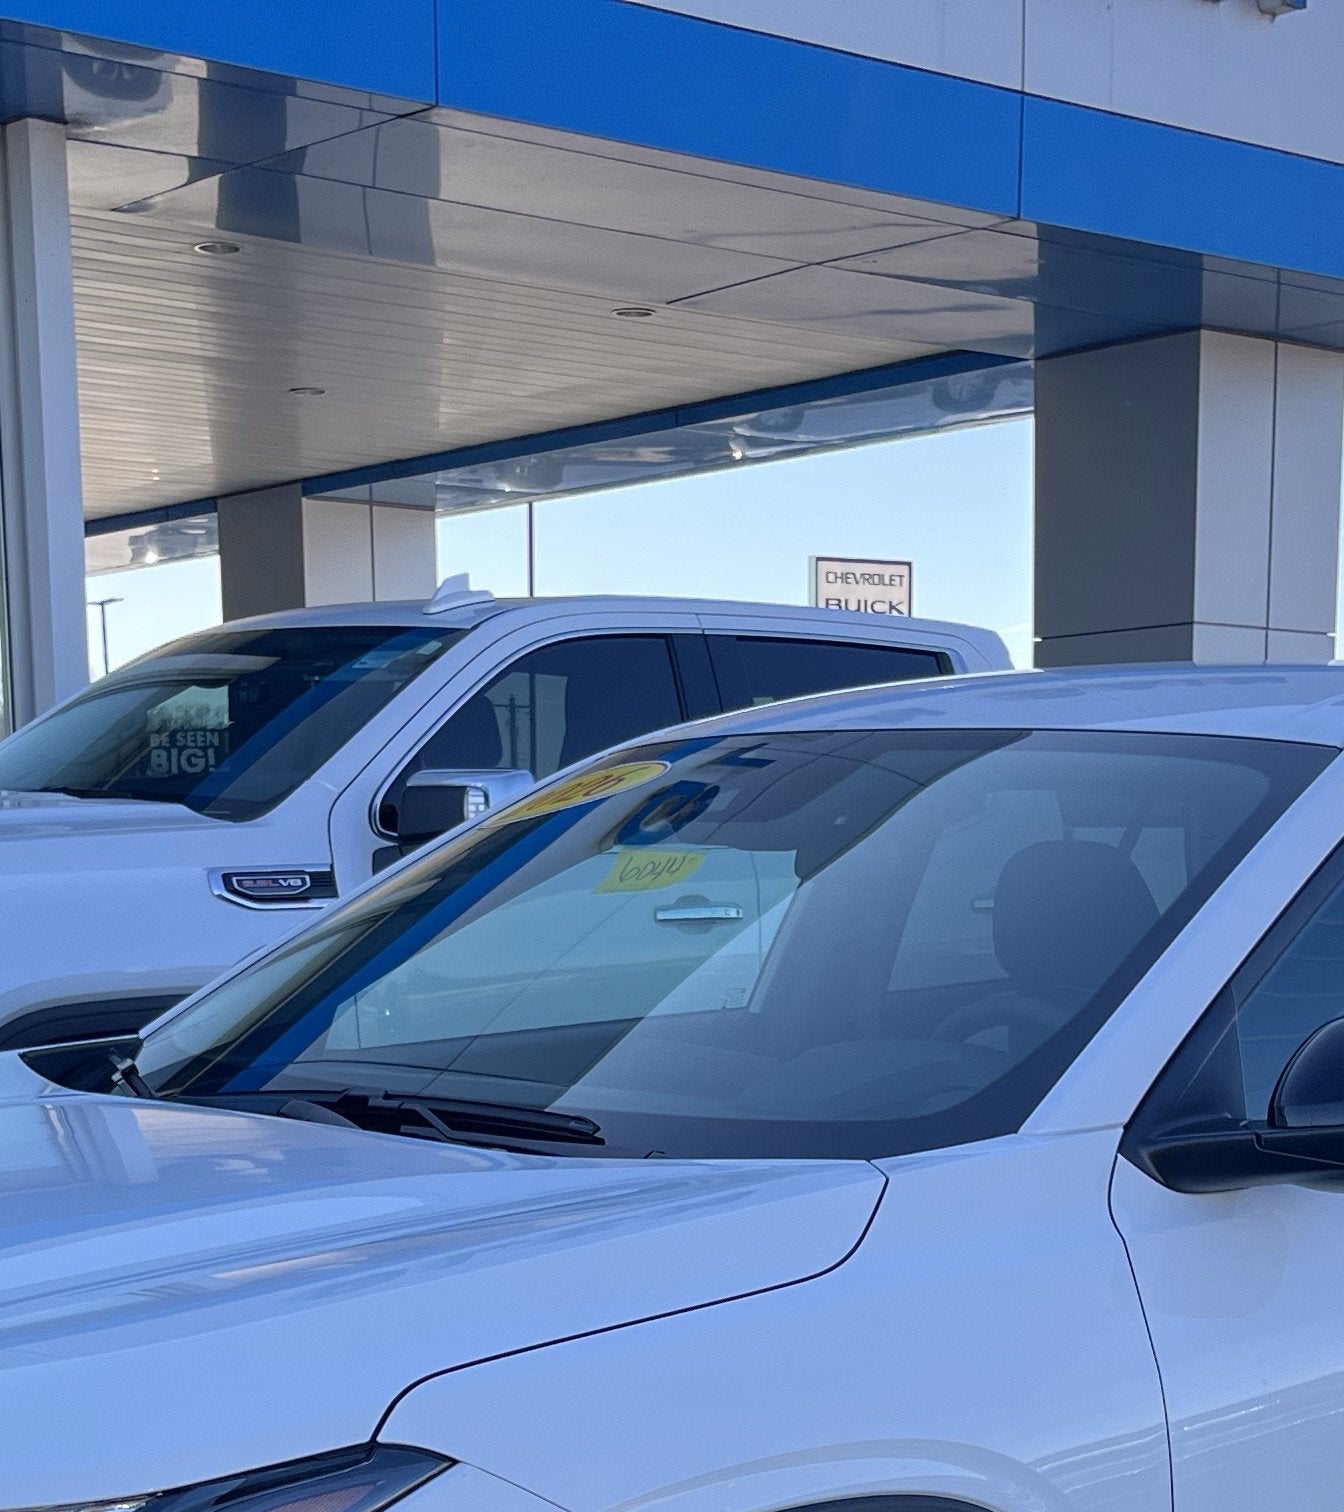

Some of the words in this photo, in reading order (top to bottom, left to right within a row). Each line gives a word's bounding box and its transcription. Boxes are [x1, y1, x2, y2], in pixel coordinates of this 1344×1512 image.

[825, 571, 905, 587] CHEVROLET
[825, 597, 905, 615] BUICK
[150, 732, 170, 748] BE
[176, 731, 219, 747] SEEN
[151, 748, 216, 774] BIG!
